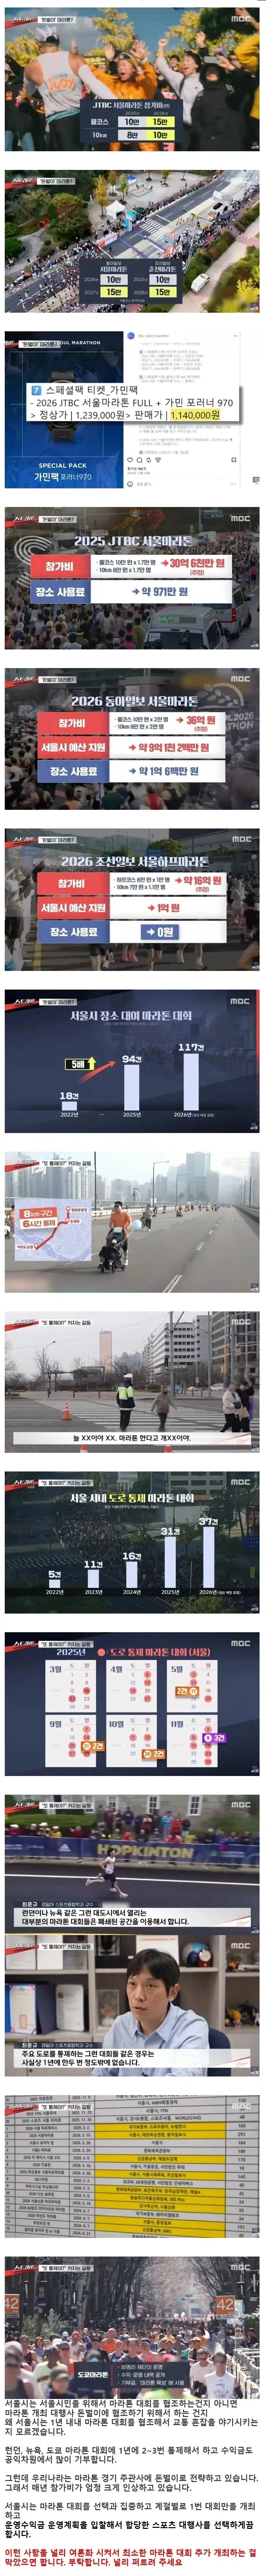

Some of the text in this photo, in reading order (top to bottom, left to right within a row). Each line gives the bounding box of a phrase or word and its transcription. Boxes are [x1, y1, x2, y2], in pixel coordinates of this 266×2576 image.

[46, 386, 137, 395] 스페셜팩 티켓_가민팩
[83, 398, 129, 407] 서울마라톤
[166, 398, 182, 407] 가민
[187, 398, 213, 407] 포러너
[171, 411, 219, 419] 1,140,000원
[216, 2299, 234, 2310] 42
